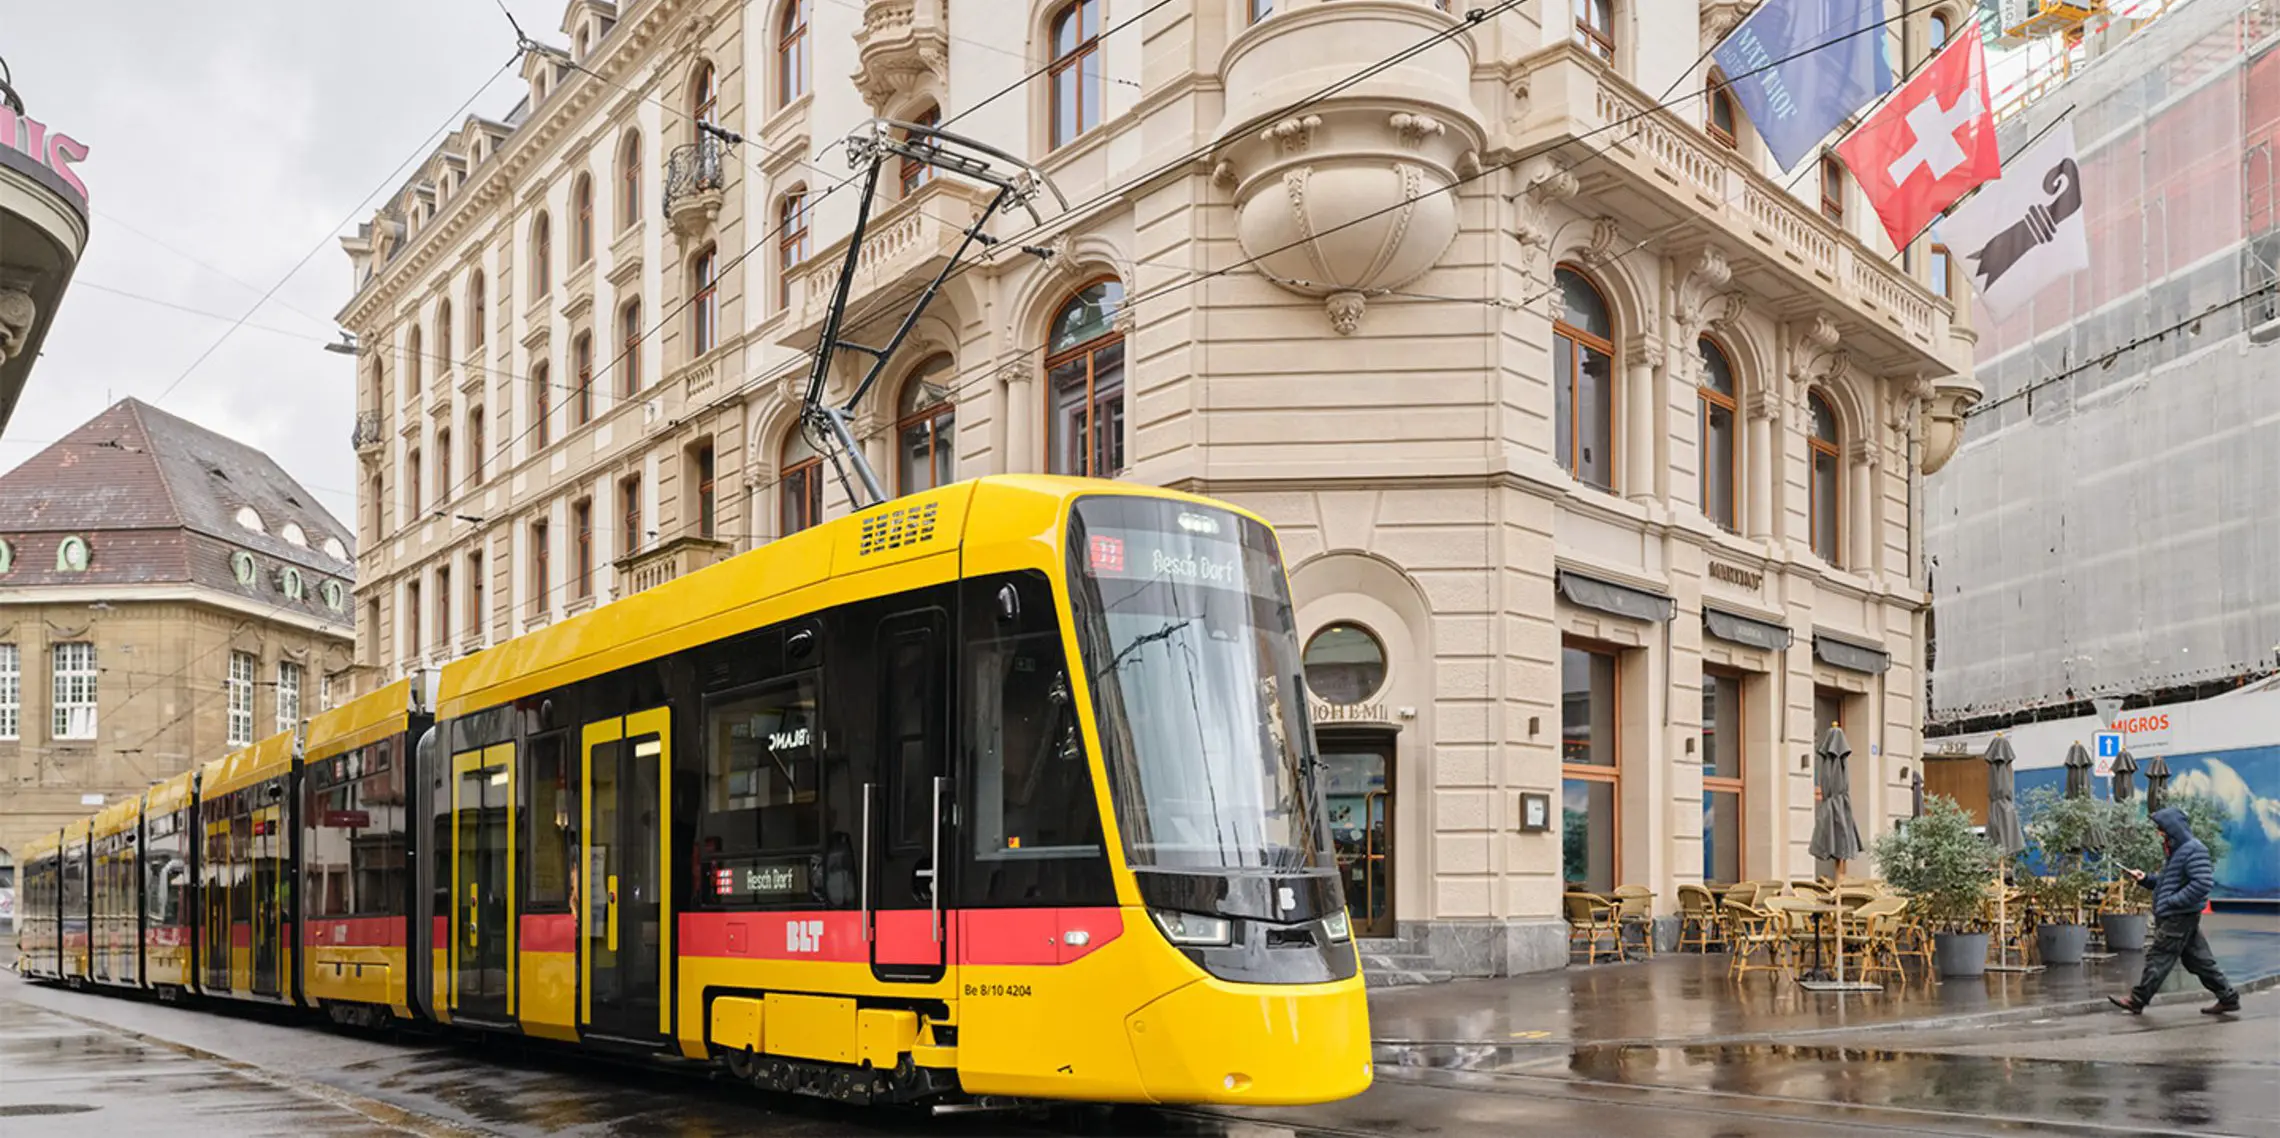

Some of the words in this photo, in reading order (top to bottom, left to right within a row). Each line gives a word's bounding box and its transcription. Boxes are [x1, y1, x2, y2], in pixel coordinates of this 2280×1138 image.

[1200, 556, 1233, 583] Dorf
[2110, 713, 2169, 733] MIGROS
[786, 920, 824, 953] BLT
[979, 984, 1004, 997] 8/10
[1006, 985, 1032, 998] 4204
